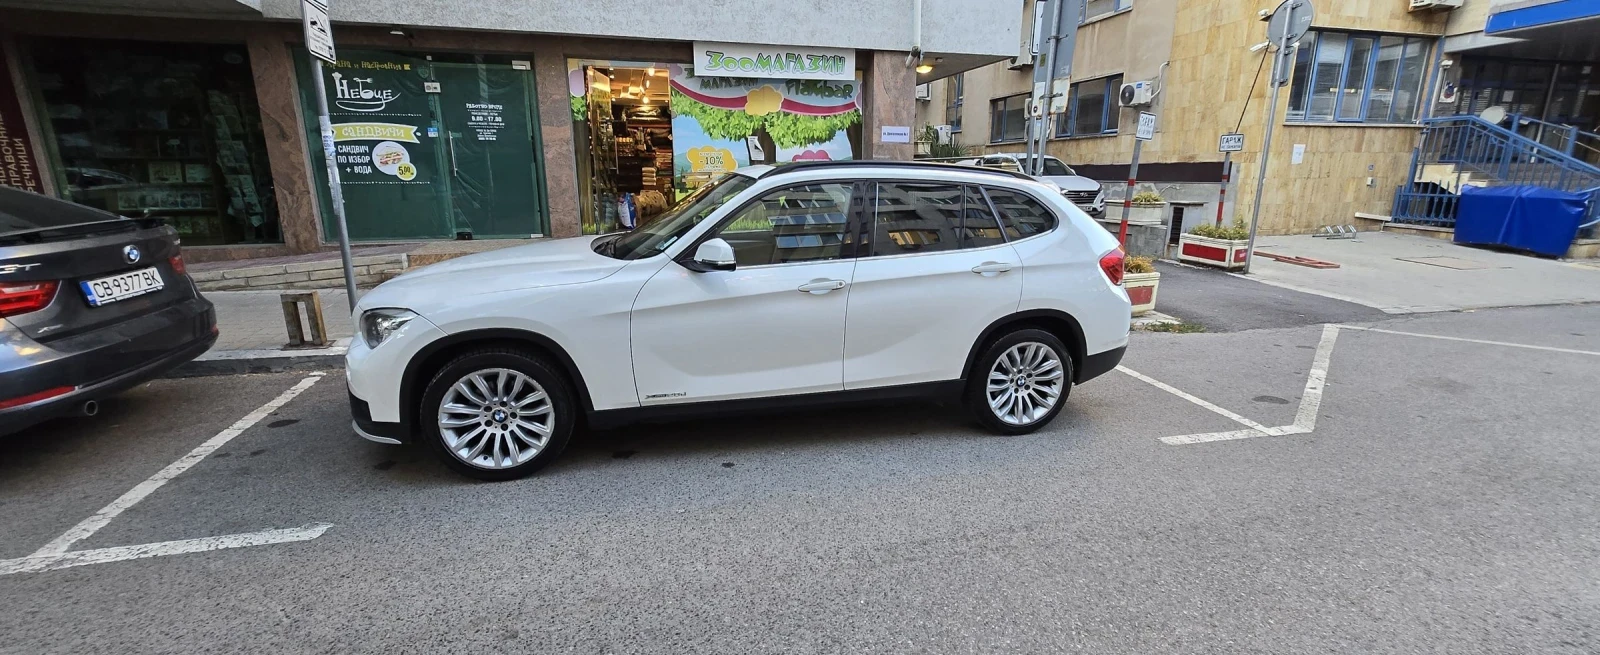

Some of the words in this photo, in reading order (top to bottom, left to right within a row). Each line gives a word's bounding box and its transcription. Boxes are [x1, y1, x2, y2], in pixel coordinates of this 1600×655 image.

[705, 50, 846, 75] ЗООМАГАЗИН
[341, 126, 405, 138] САНДВИЧИ
[337, 145, 370, 154] САНДВИЧ
[337, 155, 347, 163] ПО
[348, 155, 371, 164] ИЗБОР
[353, 165, 373, 174] ВОДА
[112, 273, 142, 293] 9377
